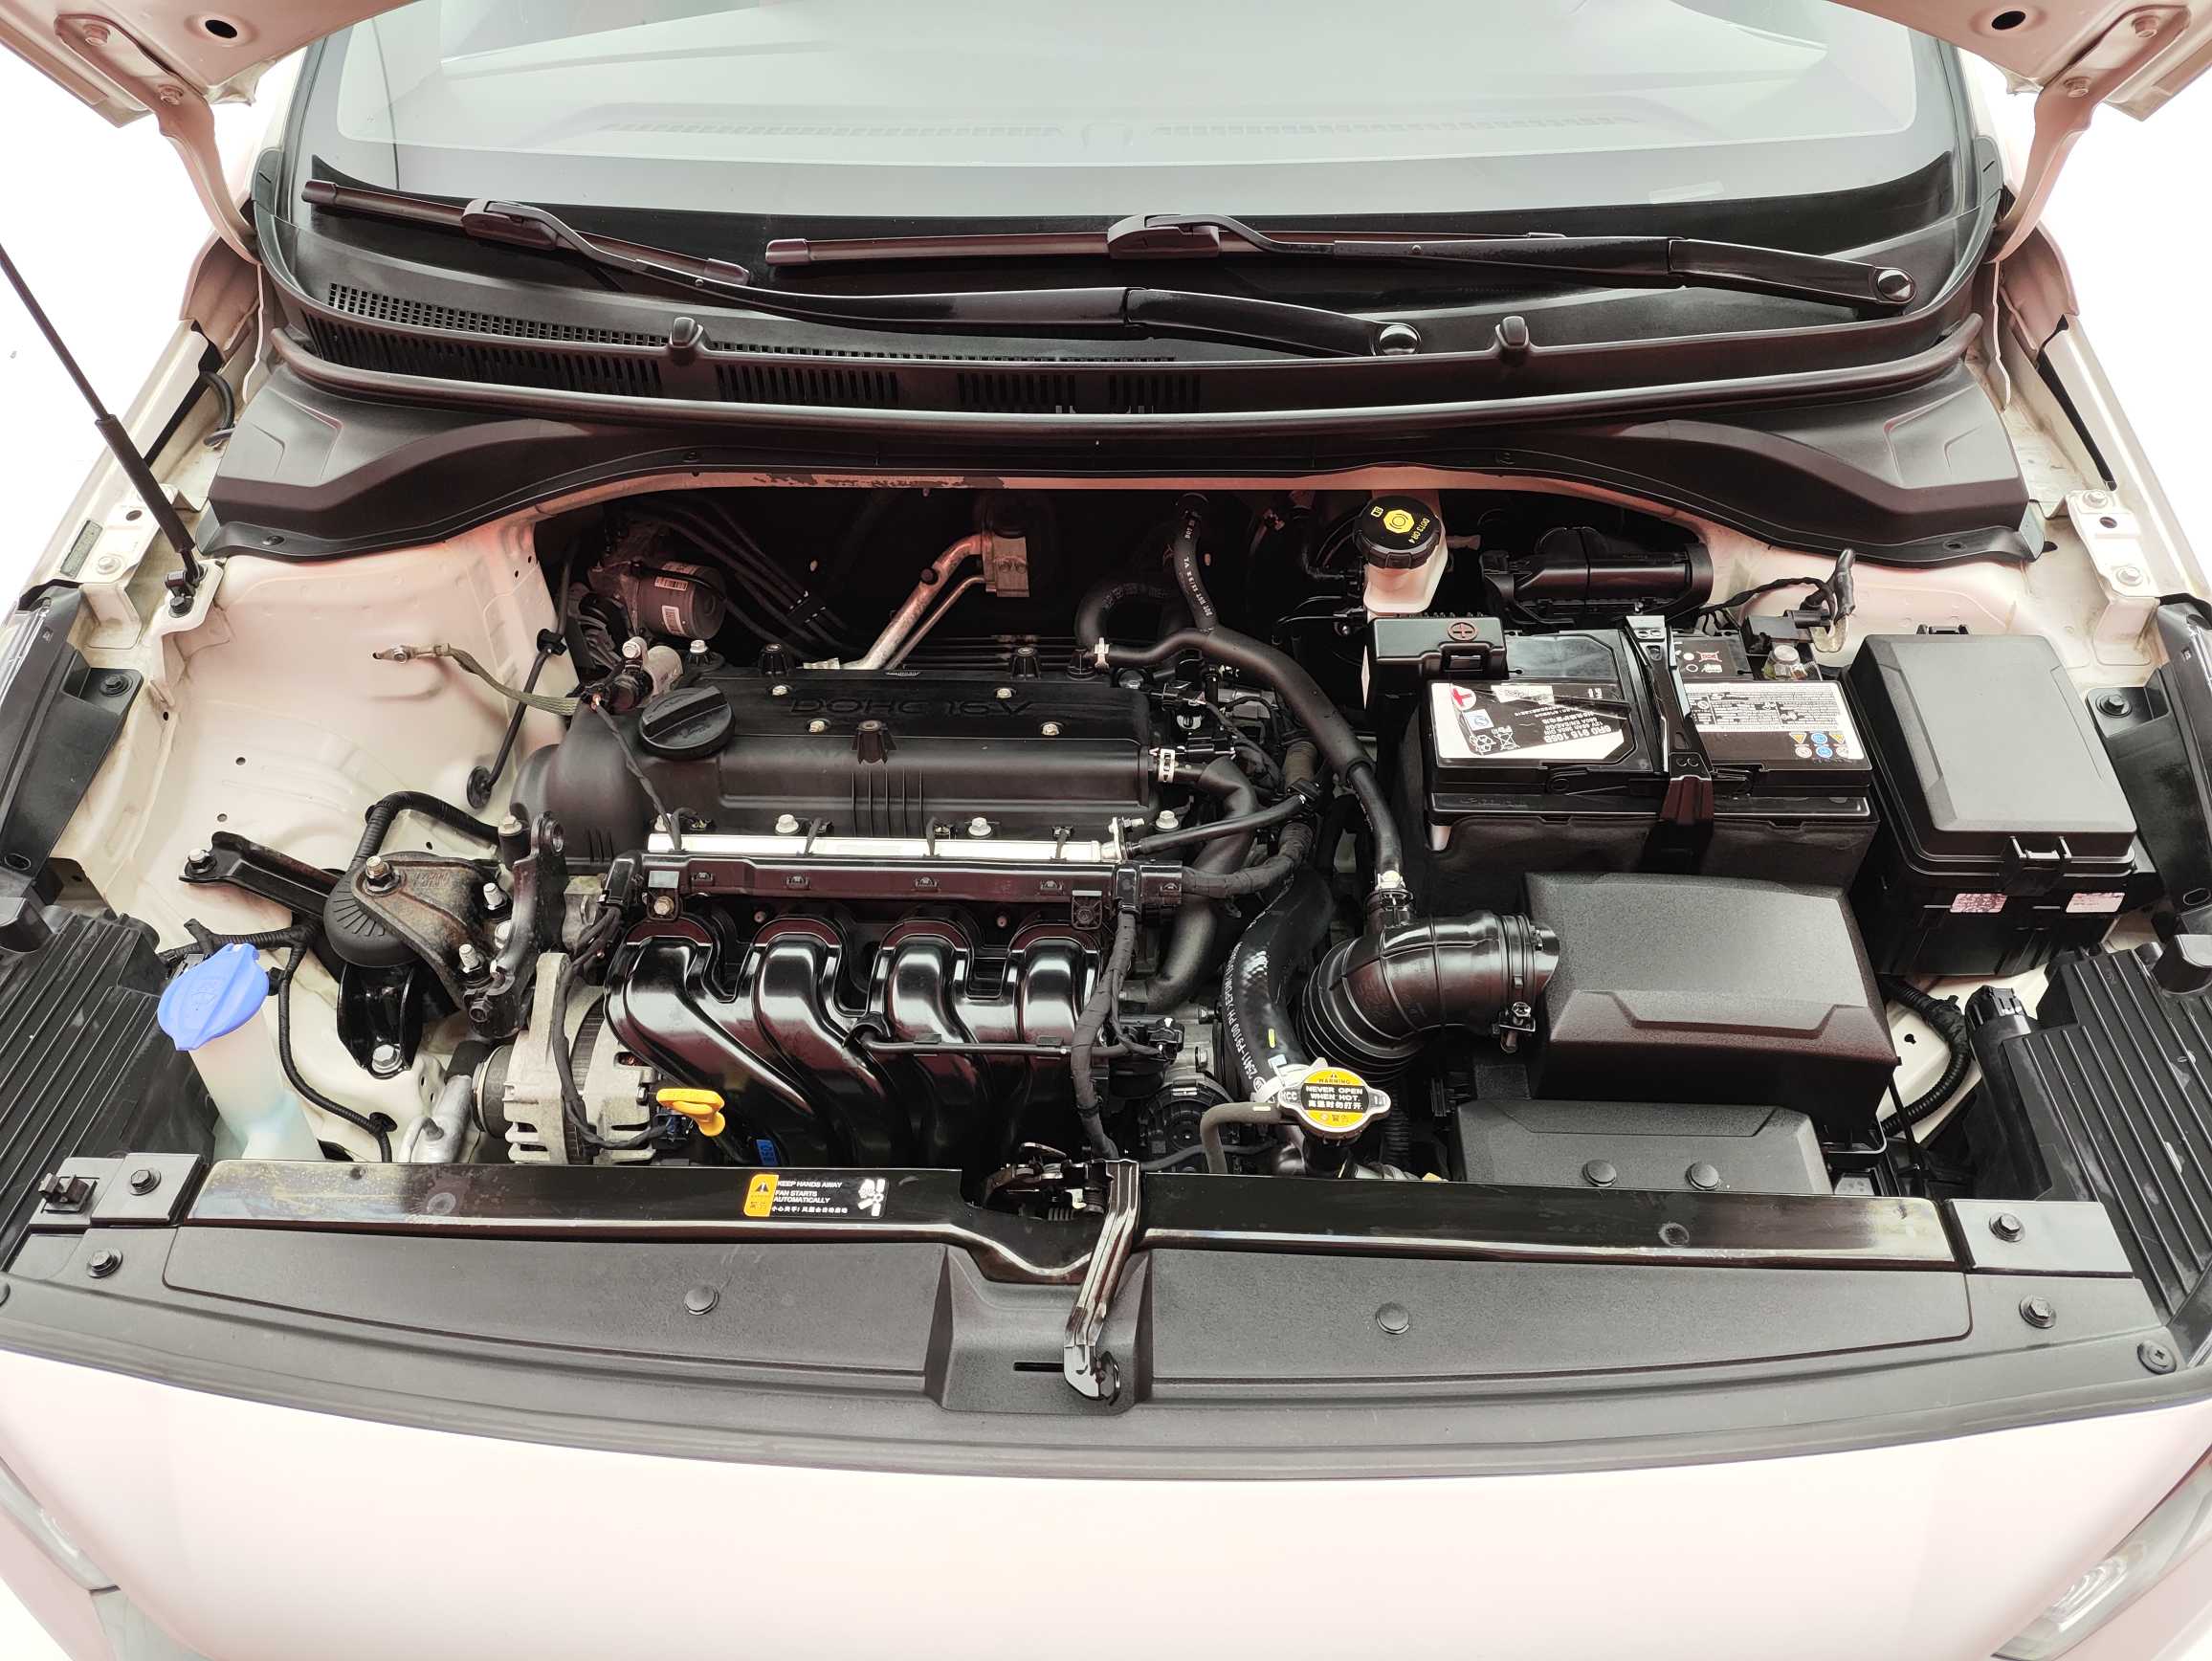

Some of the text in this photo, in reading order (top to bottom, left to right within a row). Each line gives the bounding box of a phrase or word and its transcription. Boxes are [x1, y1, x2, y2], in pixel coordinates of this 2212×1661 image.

[790, 698, 1032, 717] DOHC 16V
[1306, 1085, 1336, 1094] NEVER
